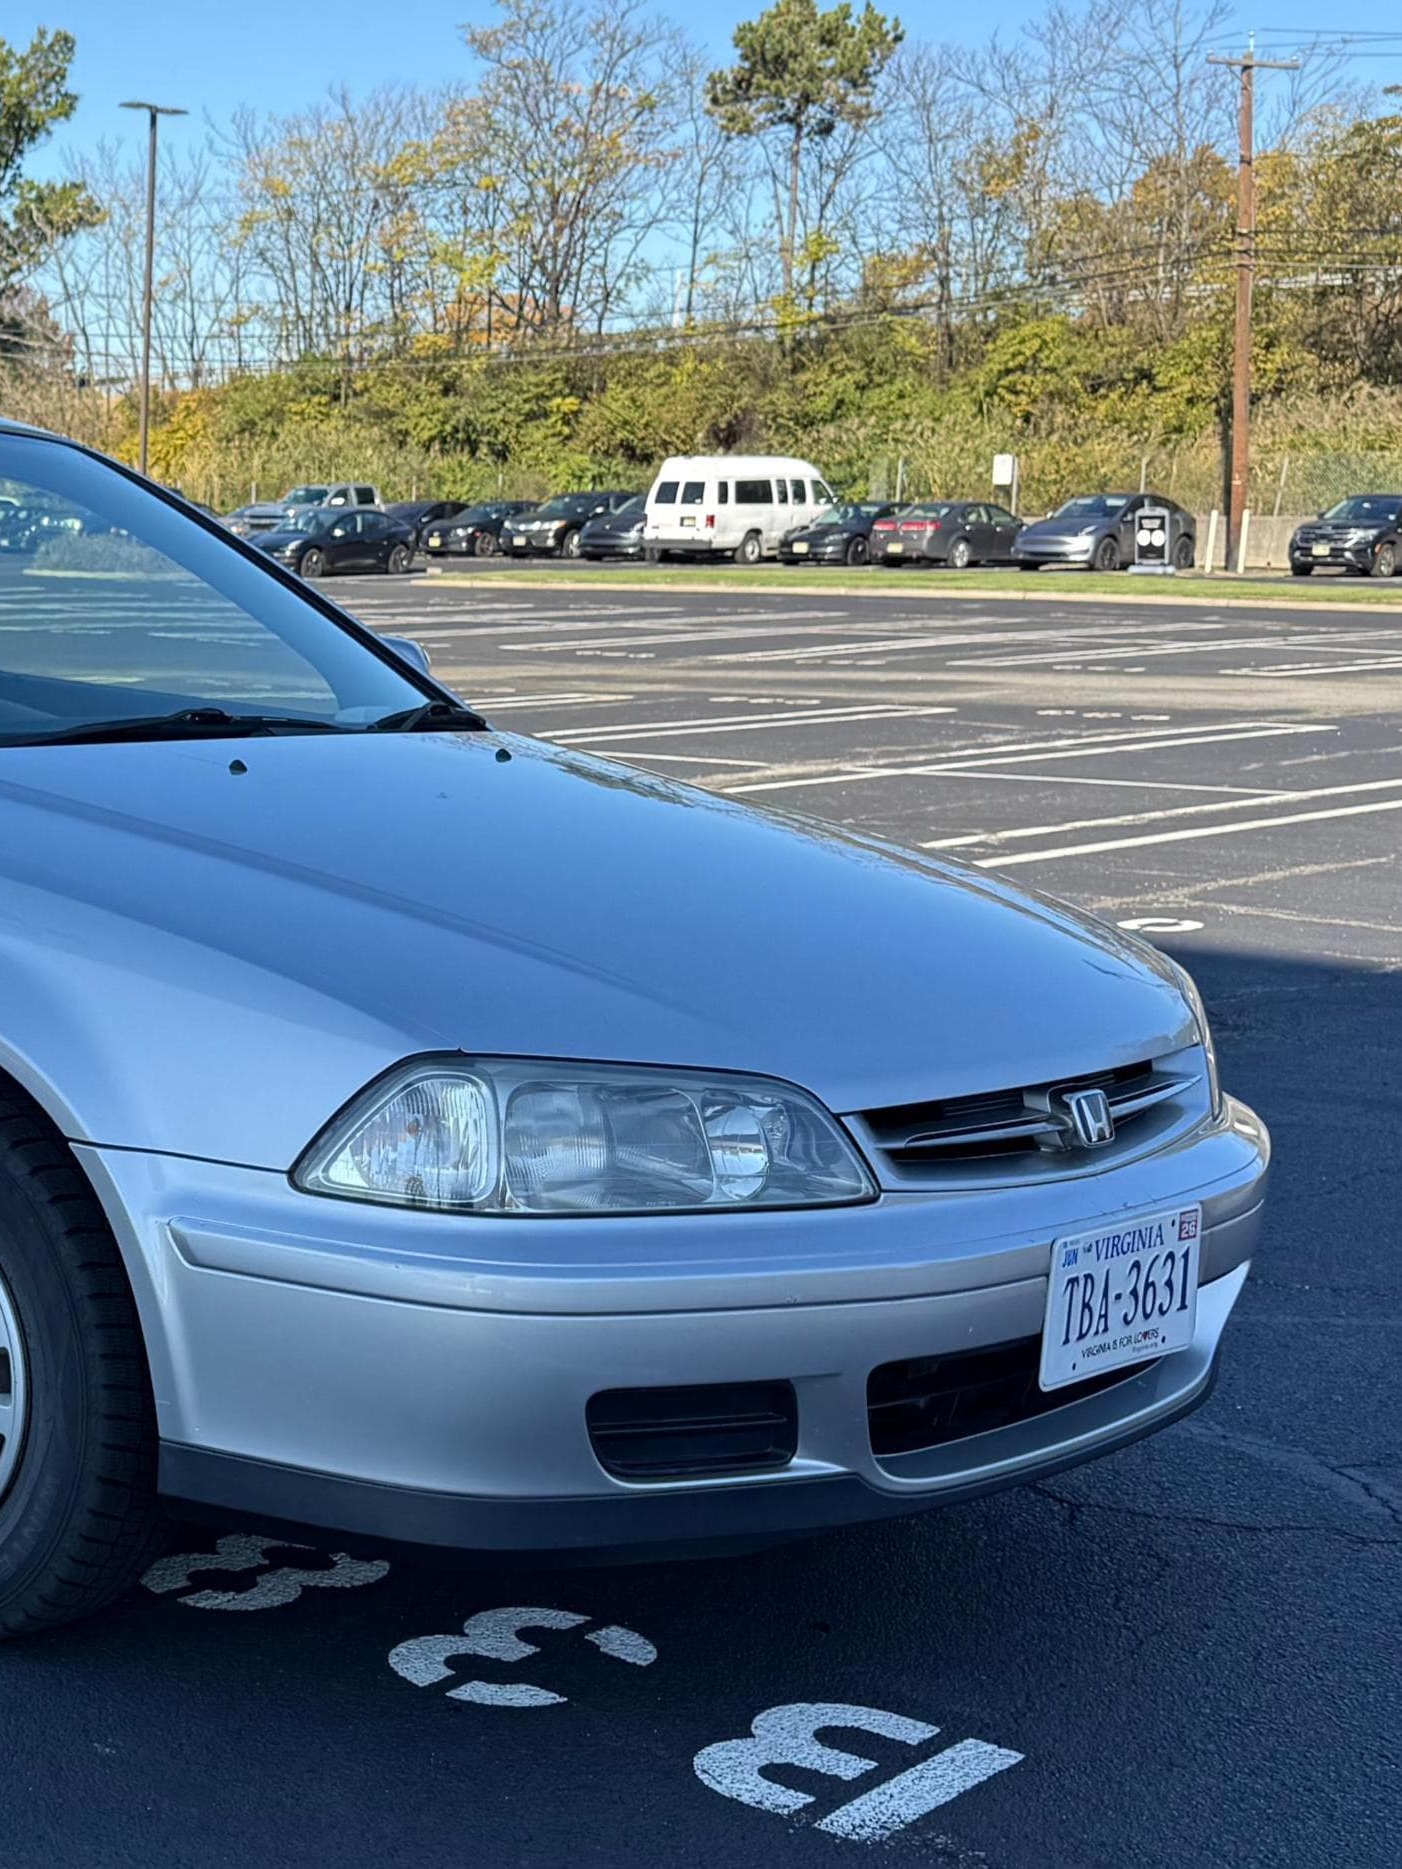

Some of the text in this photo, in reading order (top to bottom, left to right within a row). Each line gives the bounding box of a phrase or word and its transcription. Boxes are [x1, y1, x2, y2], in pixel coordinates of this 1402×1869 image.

[1062, 1247, 1079, 1268] JUN
[1094, 1223, 1165, 1262] VIRGINIA
[1061, 1245, 1191, 1346] TBA-3631
[1081, 1343, 1111, 1358] VIRGINIA
[1119, 1334, 1133, 1348] FOR
